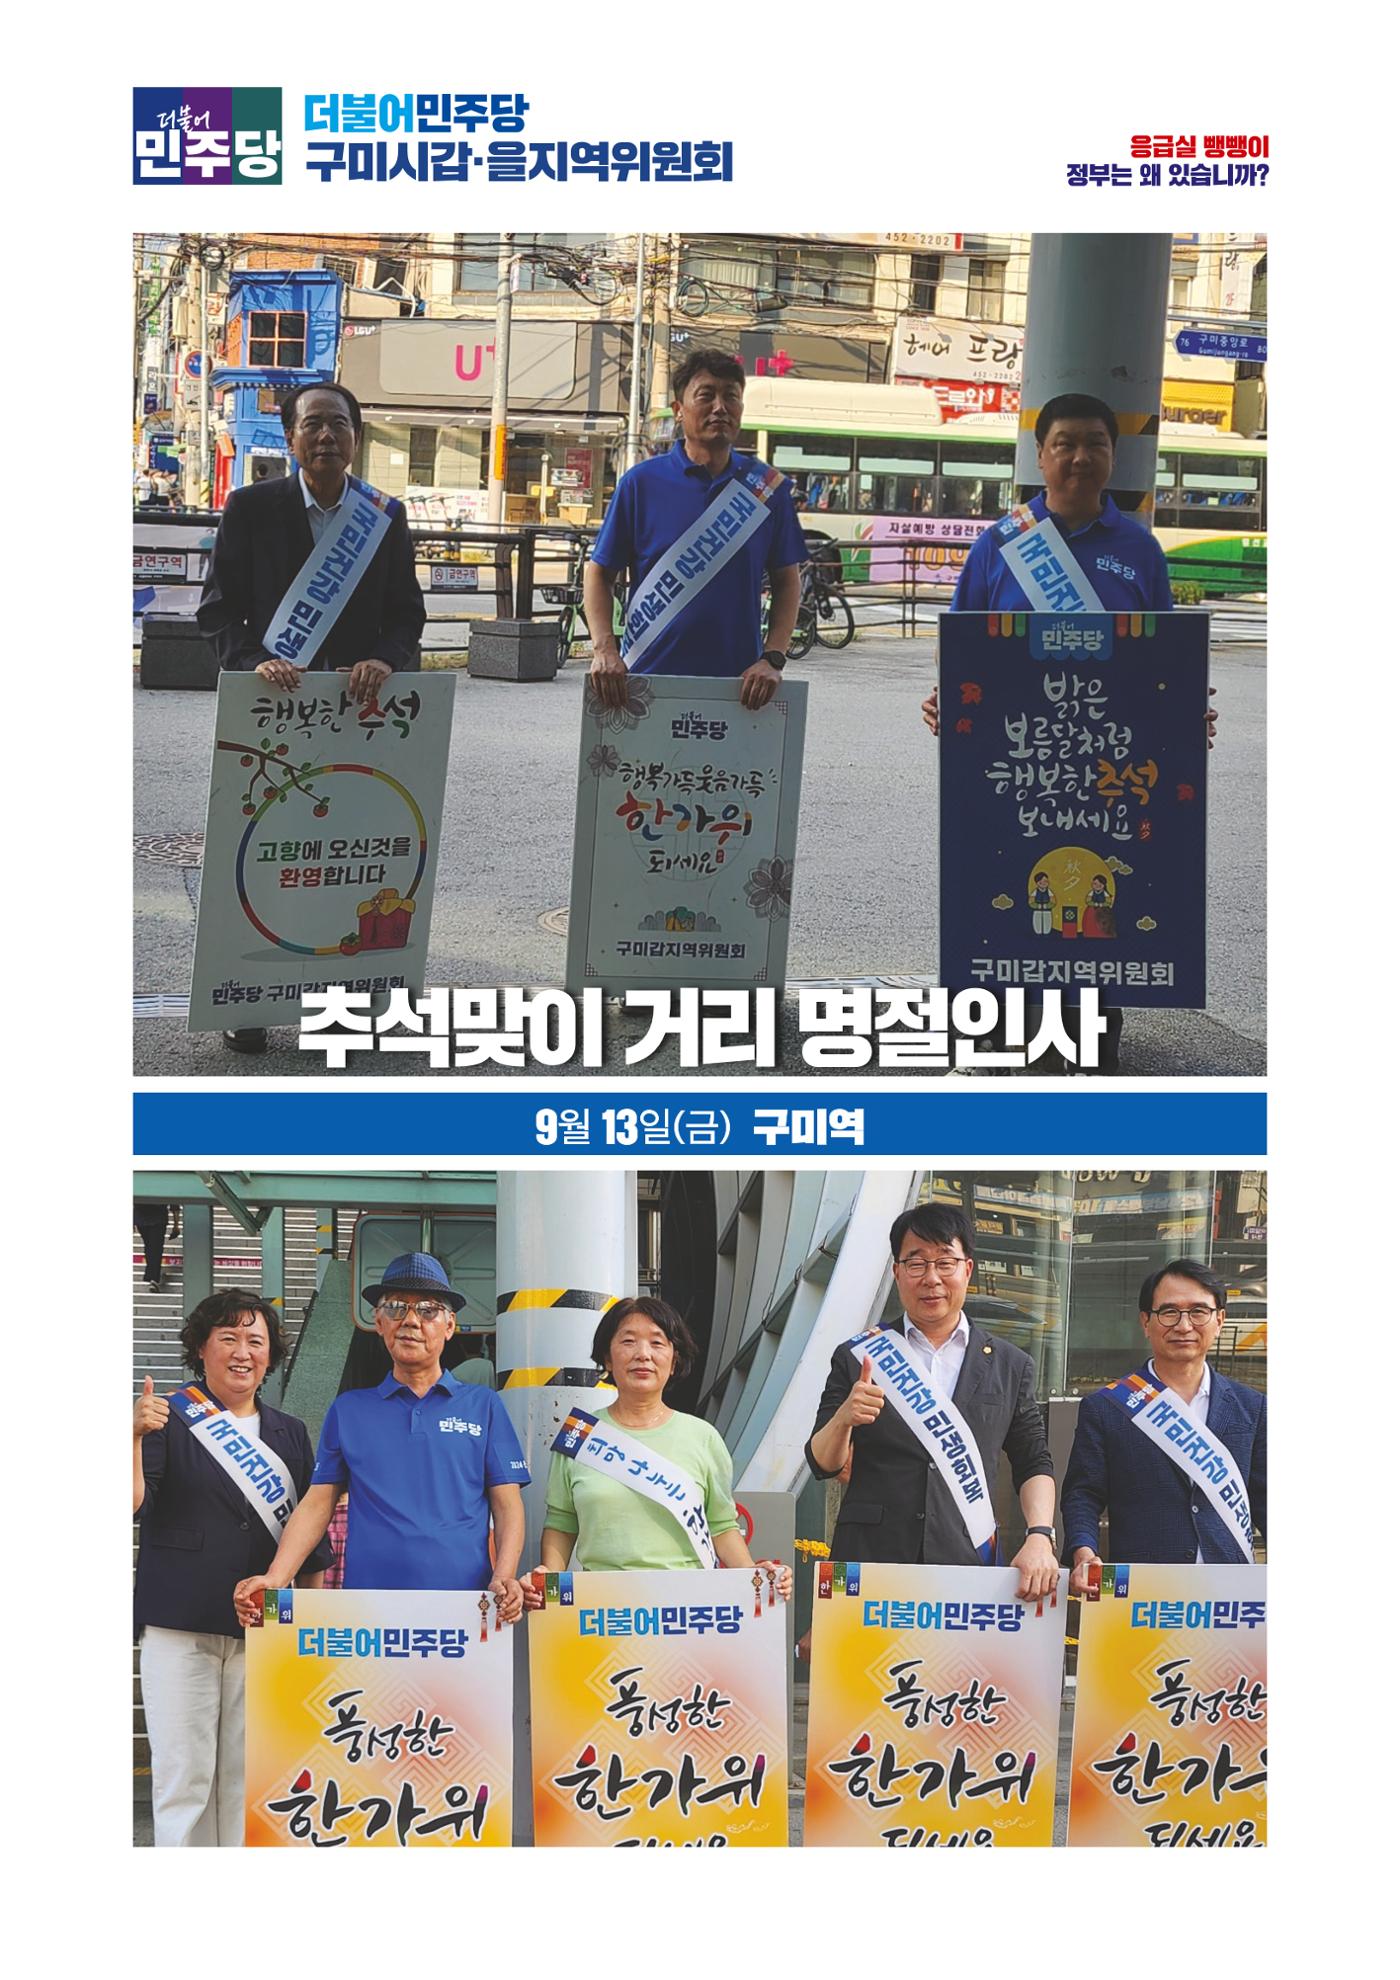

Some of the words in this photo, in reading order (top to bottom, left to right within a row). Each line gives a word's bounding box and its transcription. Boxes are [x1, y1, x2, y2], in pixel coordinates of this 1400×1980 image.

[1180, 338, 1190, 348] 76
[1199, 334, 1248, 348] 구미중앙로
[678, 491, 758, 581] 국민건강
[889, 522, 935, 535] 자살예방
[305, 502, 379, 606] 국민건강
[1095, 557, 1136, 580] 민주당
[1041, 630, 1105, 651] 민주당
[1043, 671, 1109, 719] 밝은
[250, 690, 353, 741] 행복한
[671, 718, 728, 741] 민주당
[1004, 712, 1133, 761] 보름달처럼
[616, 790, 753, 846] 한가위
[1018, 804, 1134, 841] 보내세요
[256, 840, 323, 862] 고향에
[647, 848, 717, 874] 되세요
[279, 865, 387, 889] 환영합니다
[616, 941, 746, 960] 구미갑지역위원회
[970, 959, 1175, 987] 구미갑지역위원회
[212, 985, 263, 1006] 민주당
[439, 1419, 482, 1437] 민주당
[864, 1335, 937, 1415] 국민건강
[922, 1409, 984, 1505] 민생회복
[205, 1418, 286, 1504] 국민건강
[1145, 1400, 1229, 1485] 국민건강
[579, 1605, 744, 1637] 더불어민주당
[863, 1600, 1025, 1633] 더불어민주당
[297, 1626, 469, 1660] 더불어민주당
[606, 1667, 731, 1737] 풍성한
[883, 1660, 1007, 1728] 풍성한
[1150, 1659, 1267, 1727] 풍성한
[323, 1690, 454, 1763] 풍성한
[554, 1744, 766, 1820] 한가위
[828, 1733, 1036, 1808] 한가위
[267, 1769, 490, 1848] 한가위
